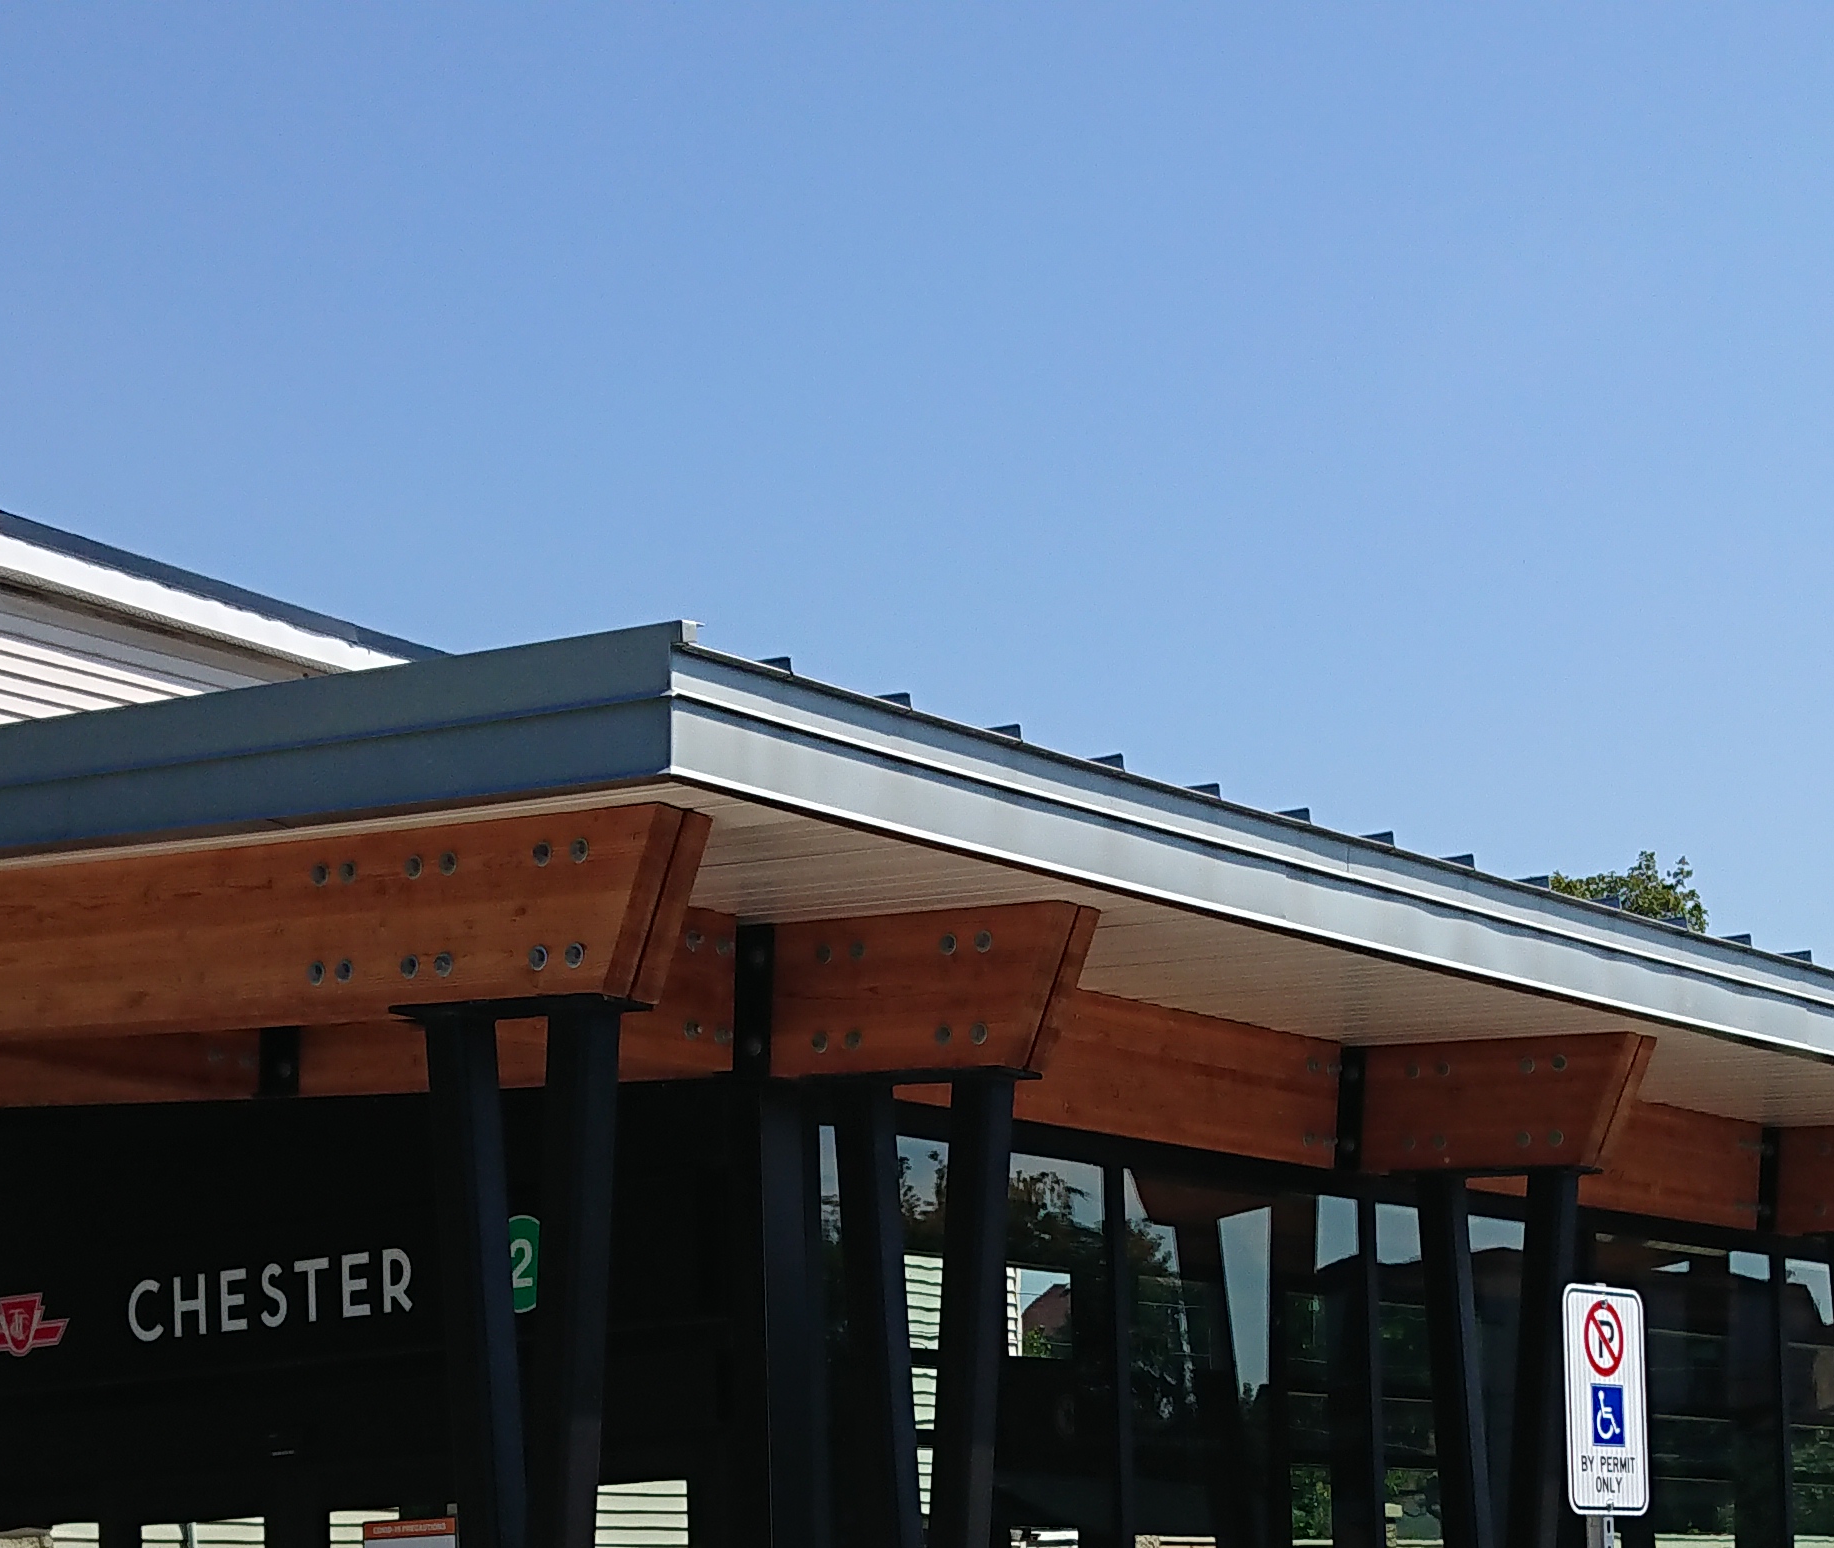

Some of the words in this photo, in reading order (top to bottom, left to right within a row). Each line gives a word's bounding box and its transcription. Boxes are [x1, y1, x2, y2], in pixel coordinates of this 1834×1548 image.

[509, 1238, 534, 1288] 2
[128, 1248, 413, 1341] CHESTER
[1581, 1455, 1595, 1473] BY
[1601, 1456, 1636, 1474] PERMIT
[1595, 1476, 1623, 1494] ONLY
